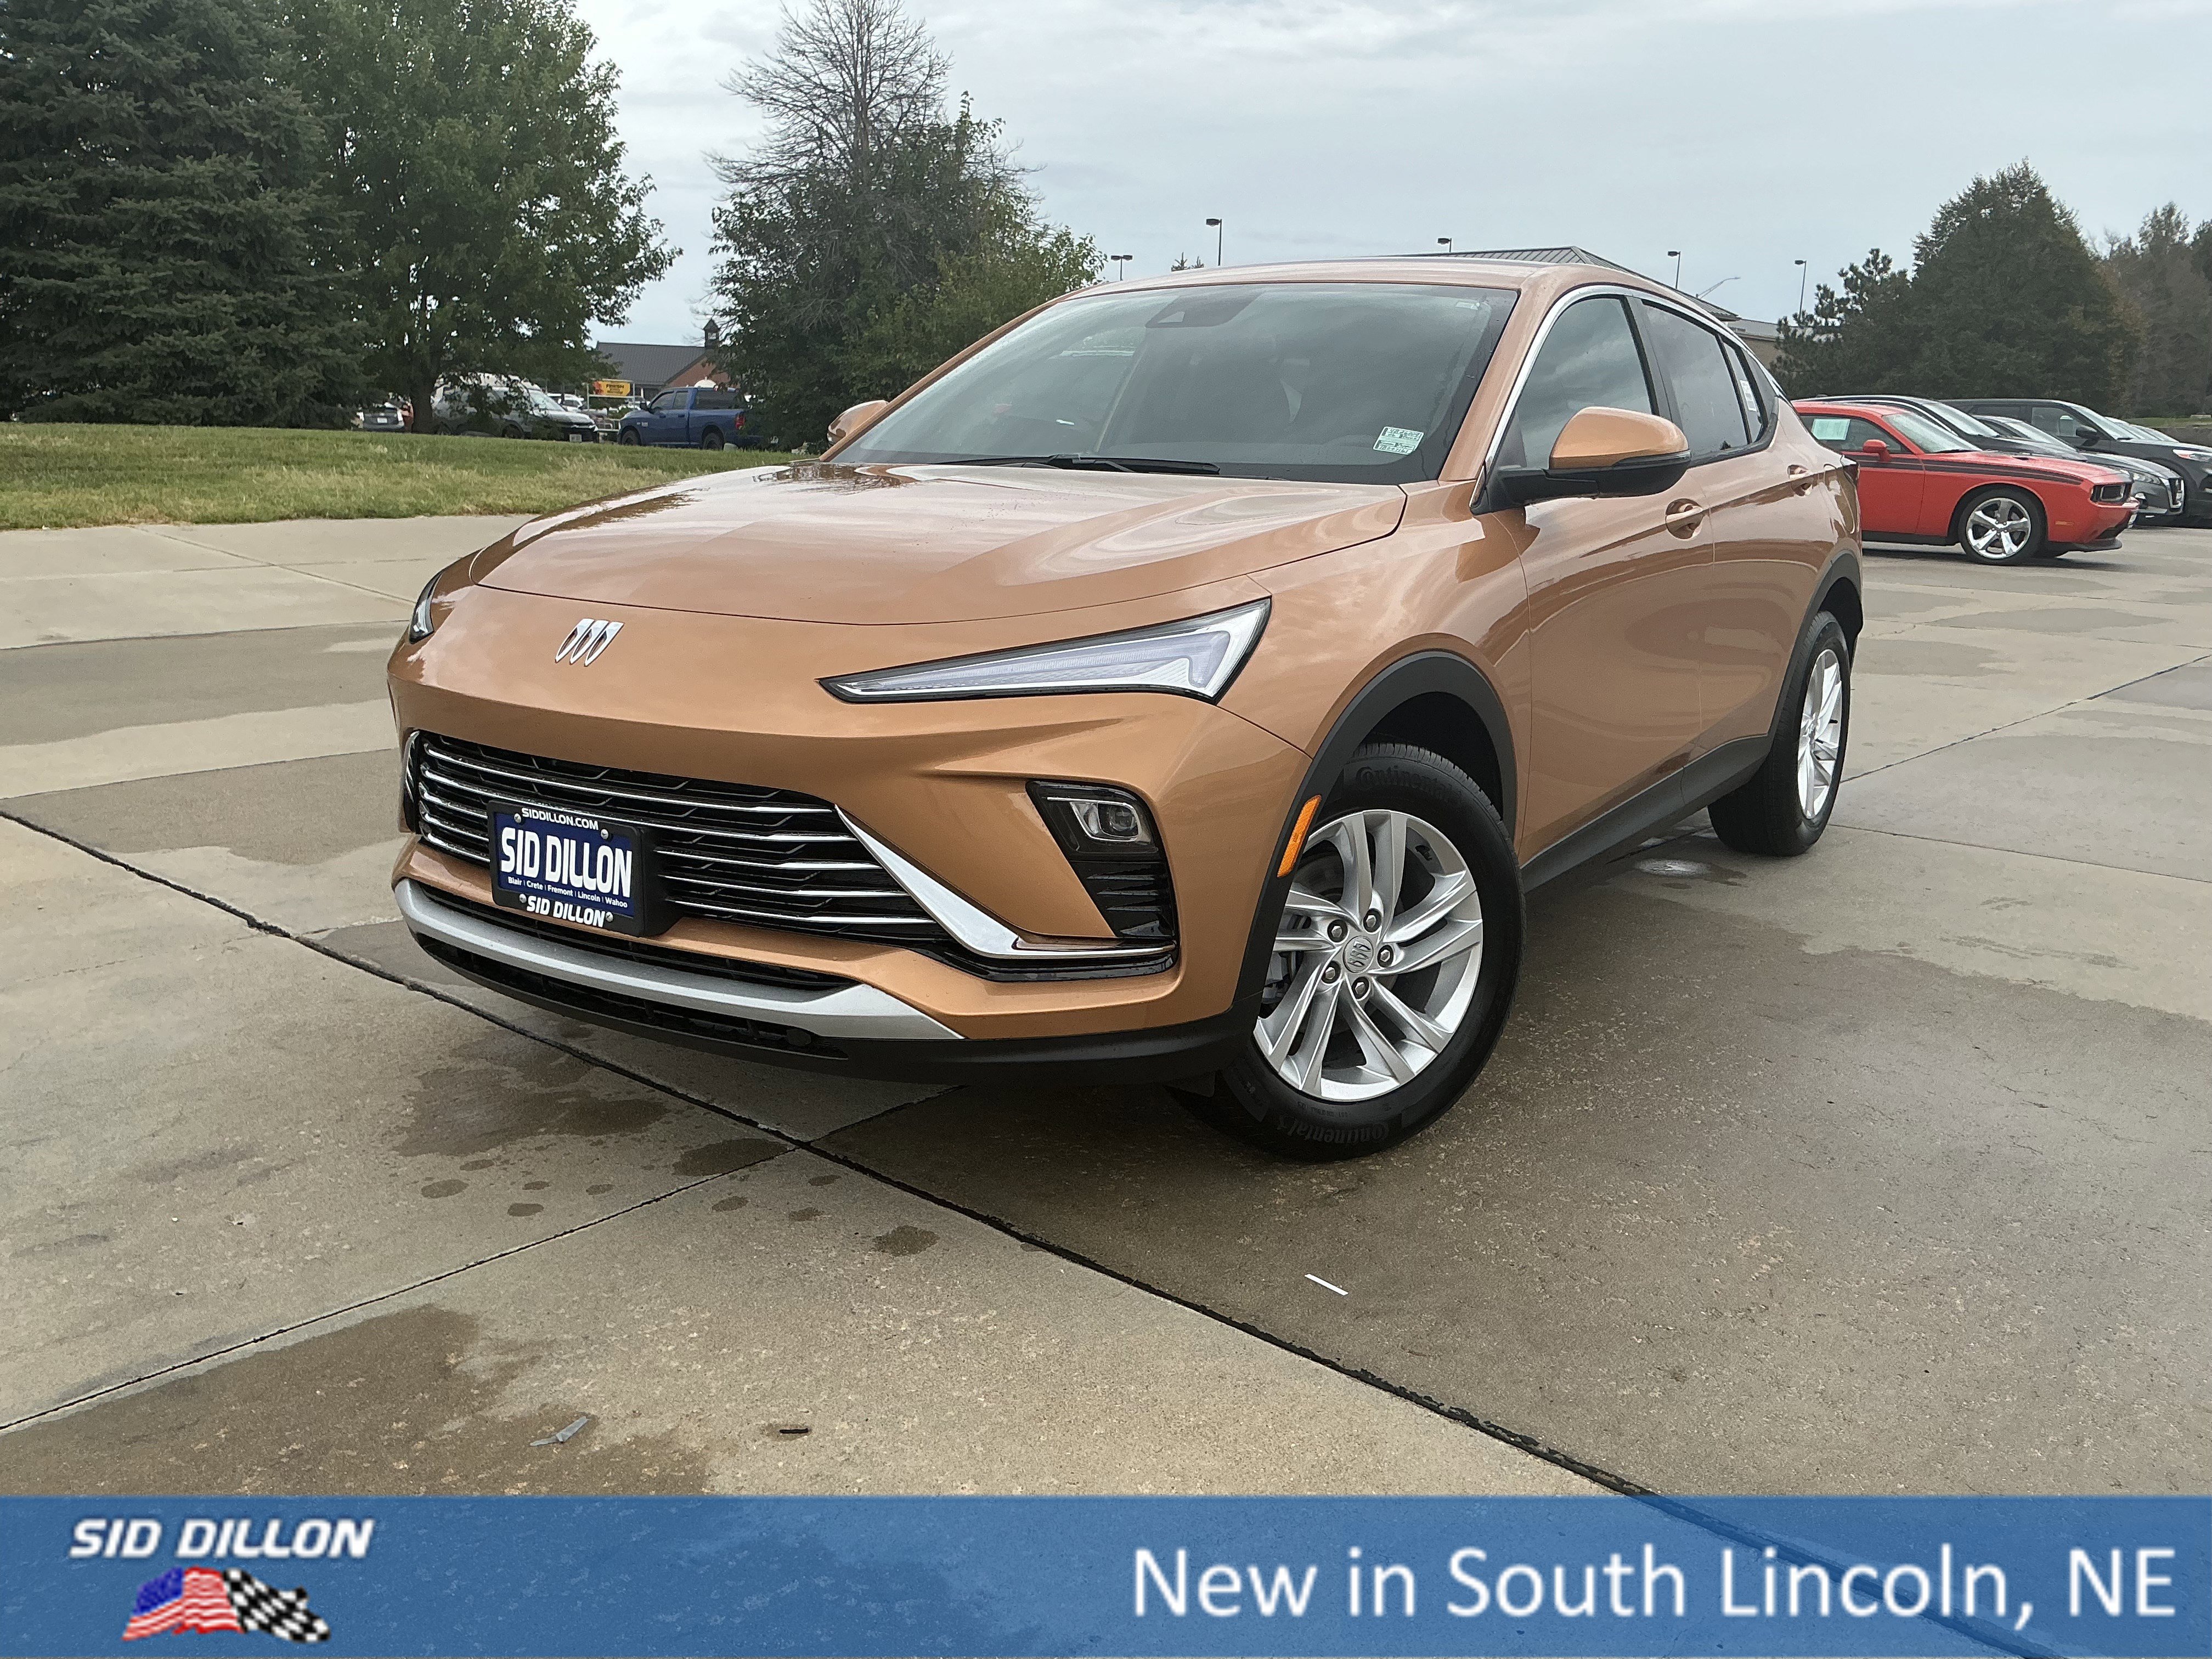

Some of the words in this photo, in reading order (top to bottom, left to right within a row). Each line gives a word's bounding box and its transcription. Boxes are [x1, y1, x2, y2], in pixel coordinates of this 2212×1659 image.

[521, 808, 599, 831] SIDDILLON.COM
[500, 827, 540, 878] SID
[545, 834, 633, 898] DILLON
[507, 876, 523, 886] Blair
[526, 879, 544, 891] Crete
[547, 884, 573, 897] Fremont
[578, 891, 601, 902] Lincoln
[605, 896, 628, 909] Wahoo
[526, 895, 551, 915] SID
[552, 901, 606, 928] DILLON
